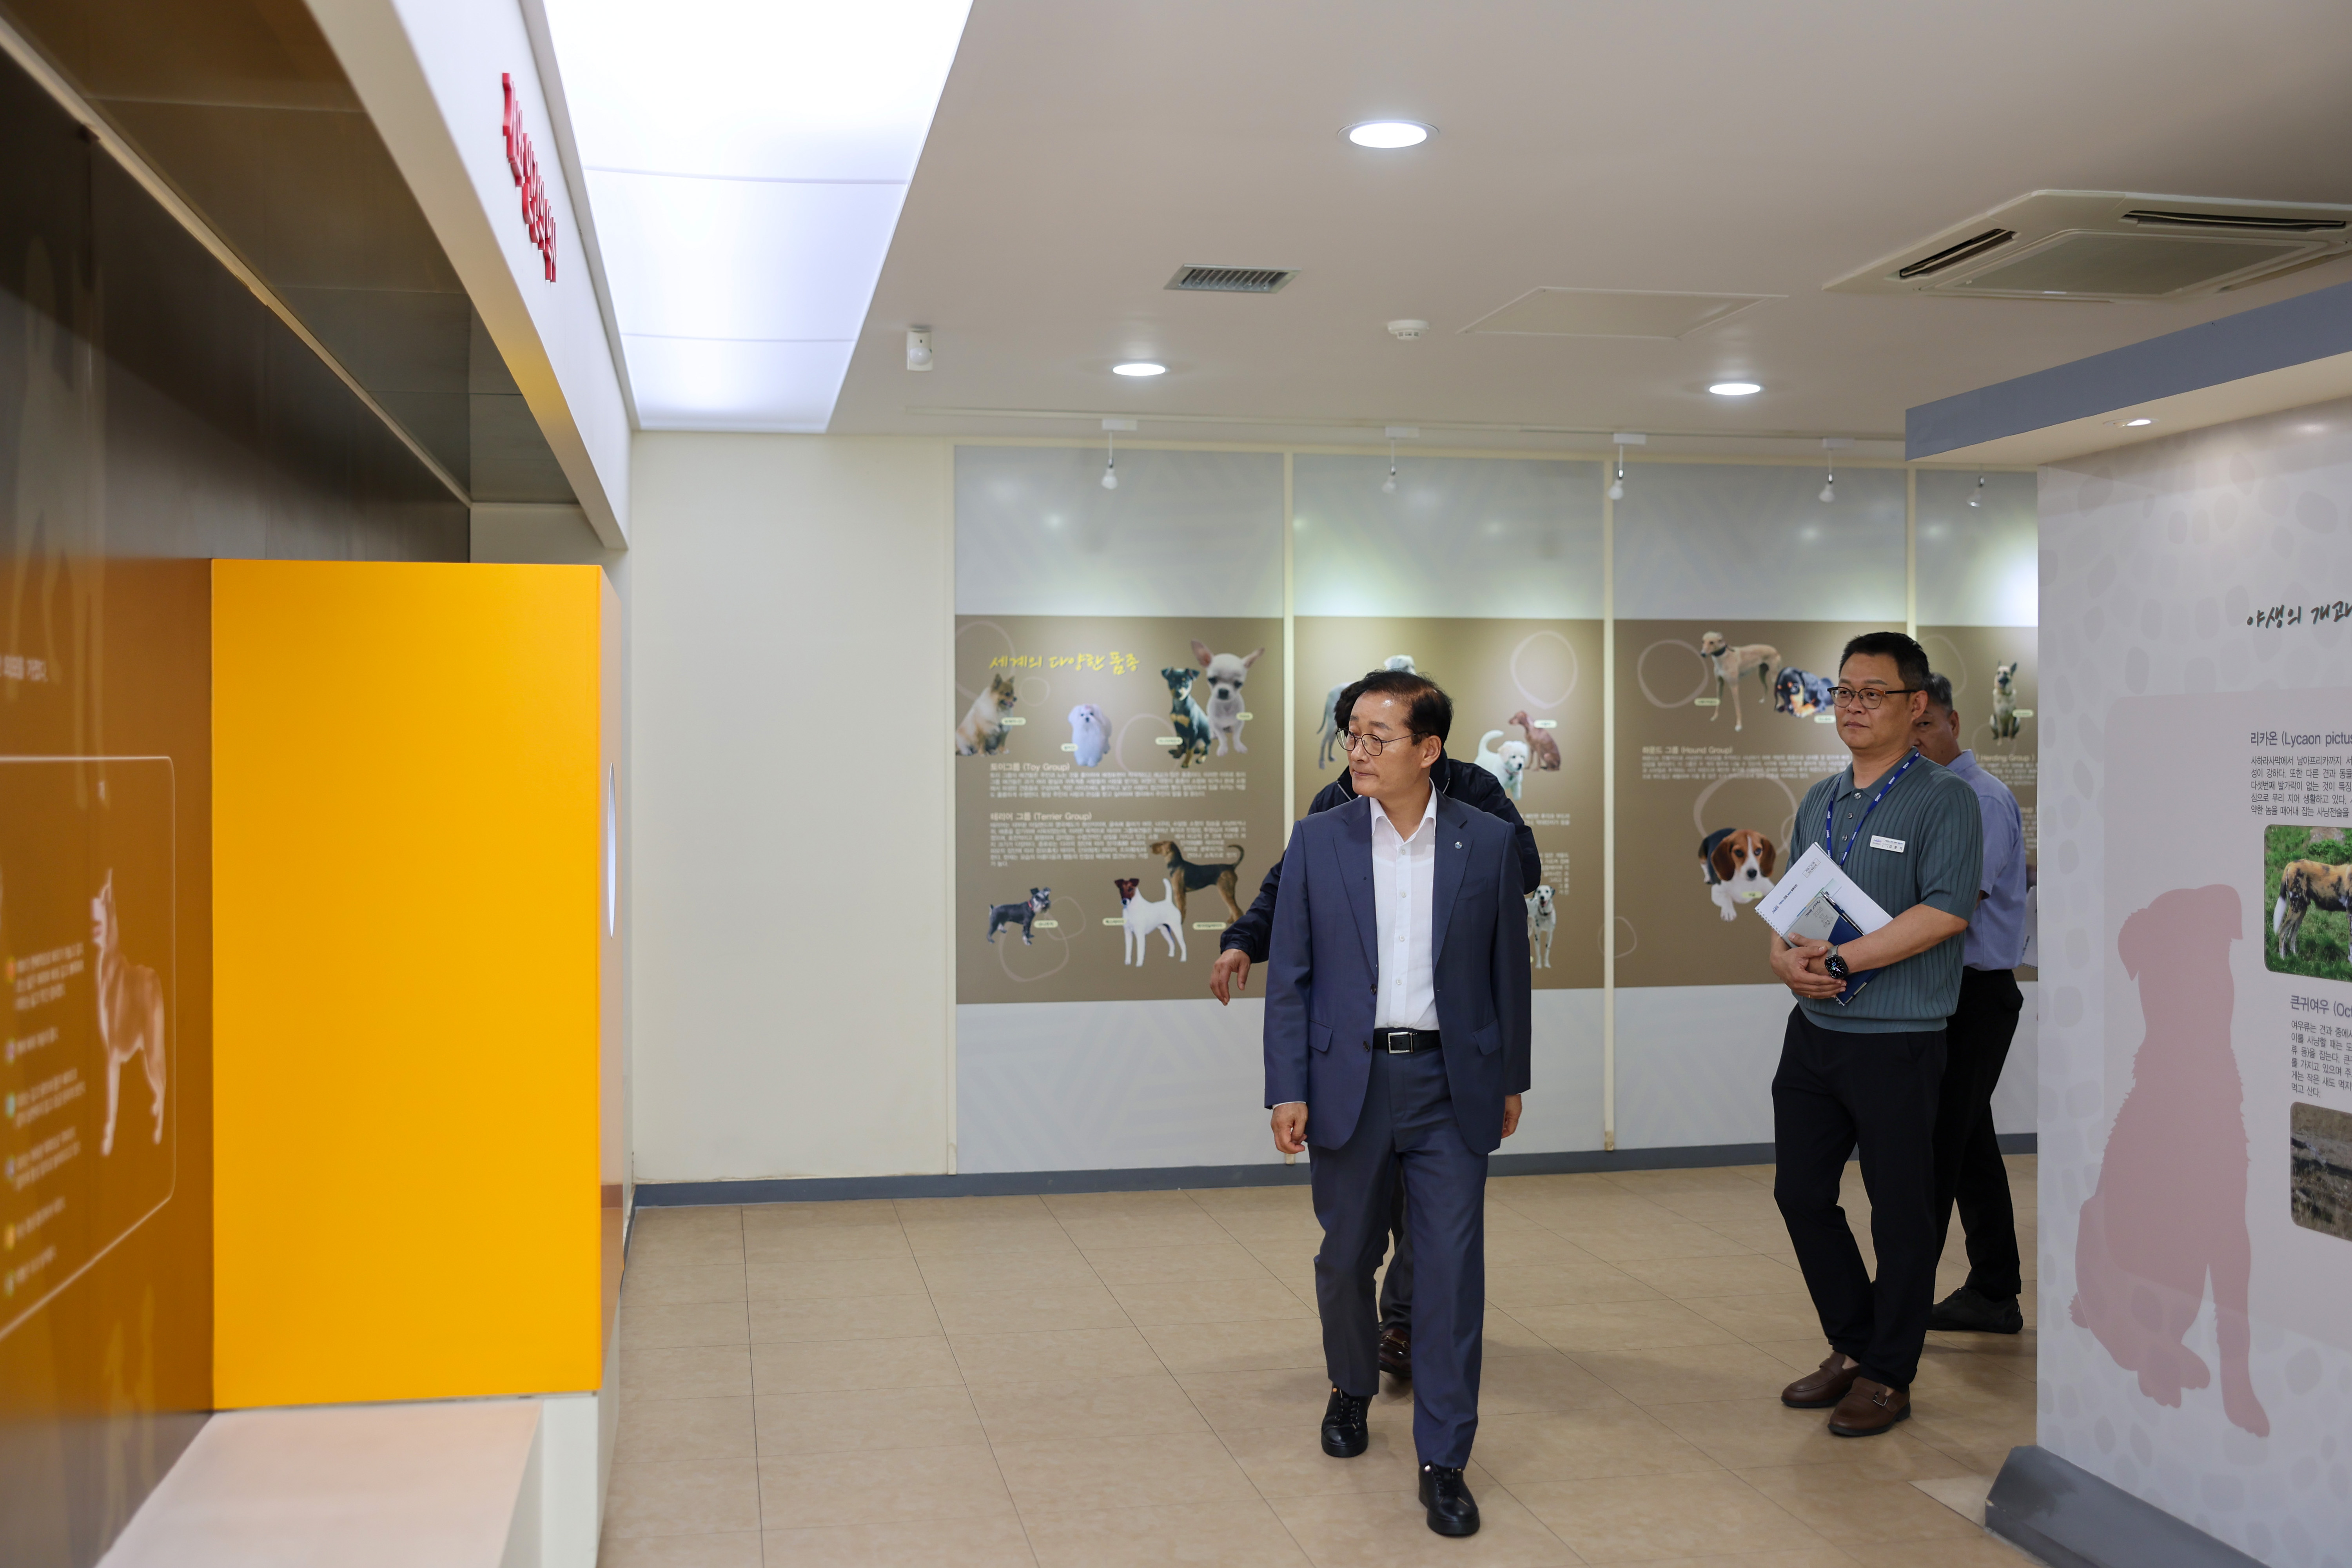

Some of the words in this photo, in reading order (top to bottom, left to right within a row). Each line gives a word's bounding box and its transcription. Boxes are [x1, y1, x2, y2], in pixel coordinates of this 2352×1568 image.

[2247, 604, 2301, 629] 야생의
[989, 655, 1043, 670] 세계의
[1048, 652, 1106, 671] 다양한
[1109, 651, 1140, 675] 품종
[2251, 731, 2278, 746] 리카온
[2282, 731, 2321, 747] (Lycaon
[1022, 762, 1041, 772] (Toy
[1042, 762, 1070, 771] Group)
[2251, 756, 2293, 765] 사하라사막에서
[2297, 756, 2341, 765] 남아프리카까지
[2251, 768, 2263, 778] 성이
[2267, 768, 2286, 778] 강하다.
[2290, 768, 2302, 778] 또한
[2307, 769, 2319, 778] 다른
[2323, 769, 2335, 779] 견과
[2251, 781, 2275, 790] 다섯번째
[2278, 781, 2302, 791] 발가락이
[2306, 781, 2319, 791] 없는
[2323, 782, 2335, 791] 것이
[2251, 793, 2269, 802] 심으로
[2272, 794, 2284, 803] 무리
[2288, 794, 2299, 803] 지어
[2303, 794, 2328, 804] 생활하고
[2332, 795, 2346, 804] 있다.
[1033, 812, 1062, 821] (Terrier
[1064, 811, 1092, 821] Group)
[2251, 806, 2263, 815] 약한
[2266, 806, 2278, 815] 놈을
[2280, 806, 2298, 816] 때어내
[2302, 807, 2314, 816] 잡는
[2317, 807, 2349, 818] 사냥전술을
[2290, 995, 2329, 1014] 큰귀여우
[2292, 1020, 2316, 1033] 여우류는
[2319, 1025, 2332, 1036] 견과
[2292, 1033, 2303, 1044] 이를
[2307, 1036, 2326, 1047] 사냥할
[2330, 1040, 2342, 1050] 때는
[2291, 1045, 2298, 1055] 류
[2301, 1047, 2315, 1058] 등)을
[2319, 1051, 2339, 1063] 잡는다.
[2344, 1055, 2352, 1065] 큰
[2292, 1058, 2298, 1067] 를
[2301, 1060, 2319, 1071] 가지고
[2323, 1063, 2342, 1076] 있으며
[2345, 1068, 2352, 1078] 주
[2292, 1071, 2304, 1082] 게는
[2307, 1073, 2319, 1085] 작은
[2323, 1076, 2335, 1087] 새도
[2338, 1080, 2352, 1091] 먹지
[2292, 1083, 2304, 1093] 먹고
[2307, 1087, 2321, 1098] 산다.
